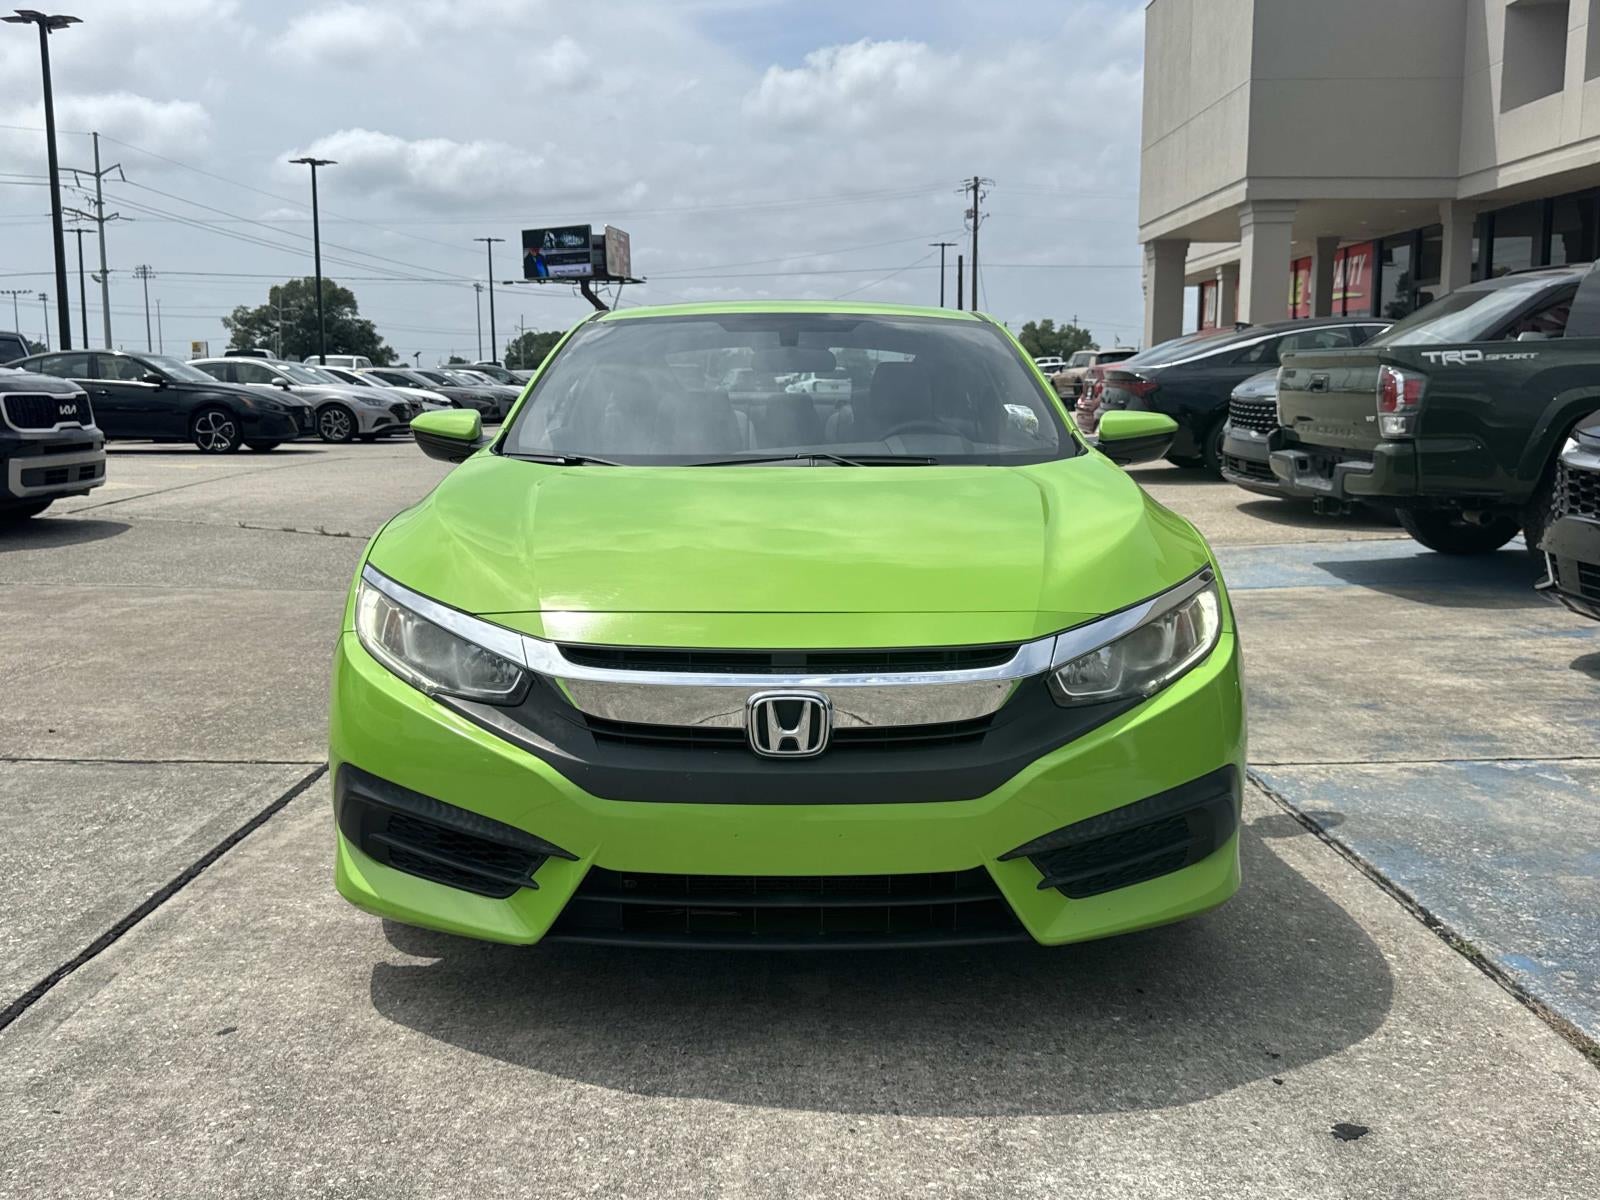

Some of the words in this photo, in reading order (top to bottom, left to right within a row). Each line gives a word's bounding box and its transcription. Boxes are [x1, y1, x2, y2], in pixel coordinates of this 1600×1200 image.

[1421, 349, 1483, 366] TRD
[1485, 352, 1540, 361] SPORT
[59, 404, 77, 415] KIA
